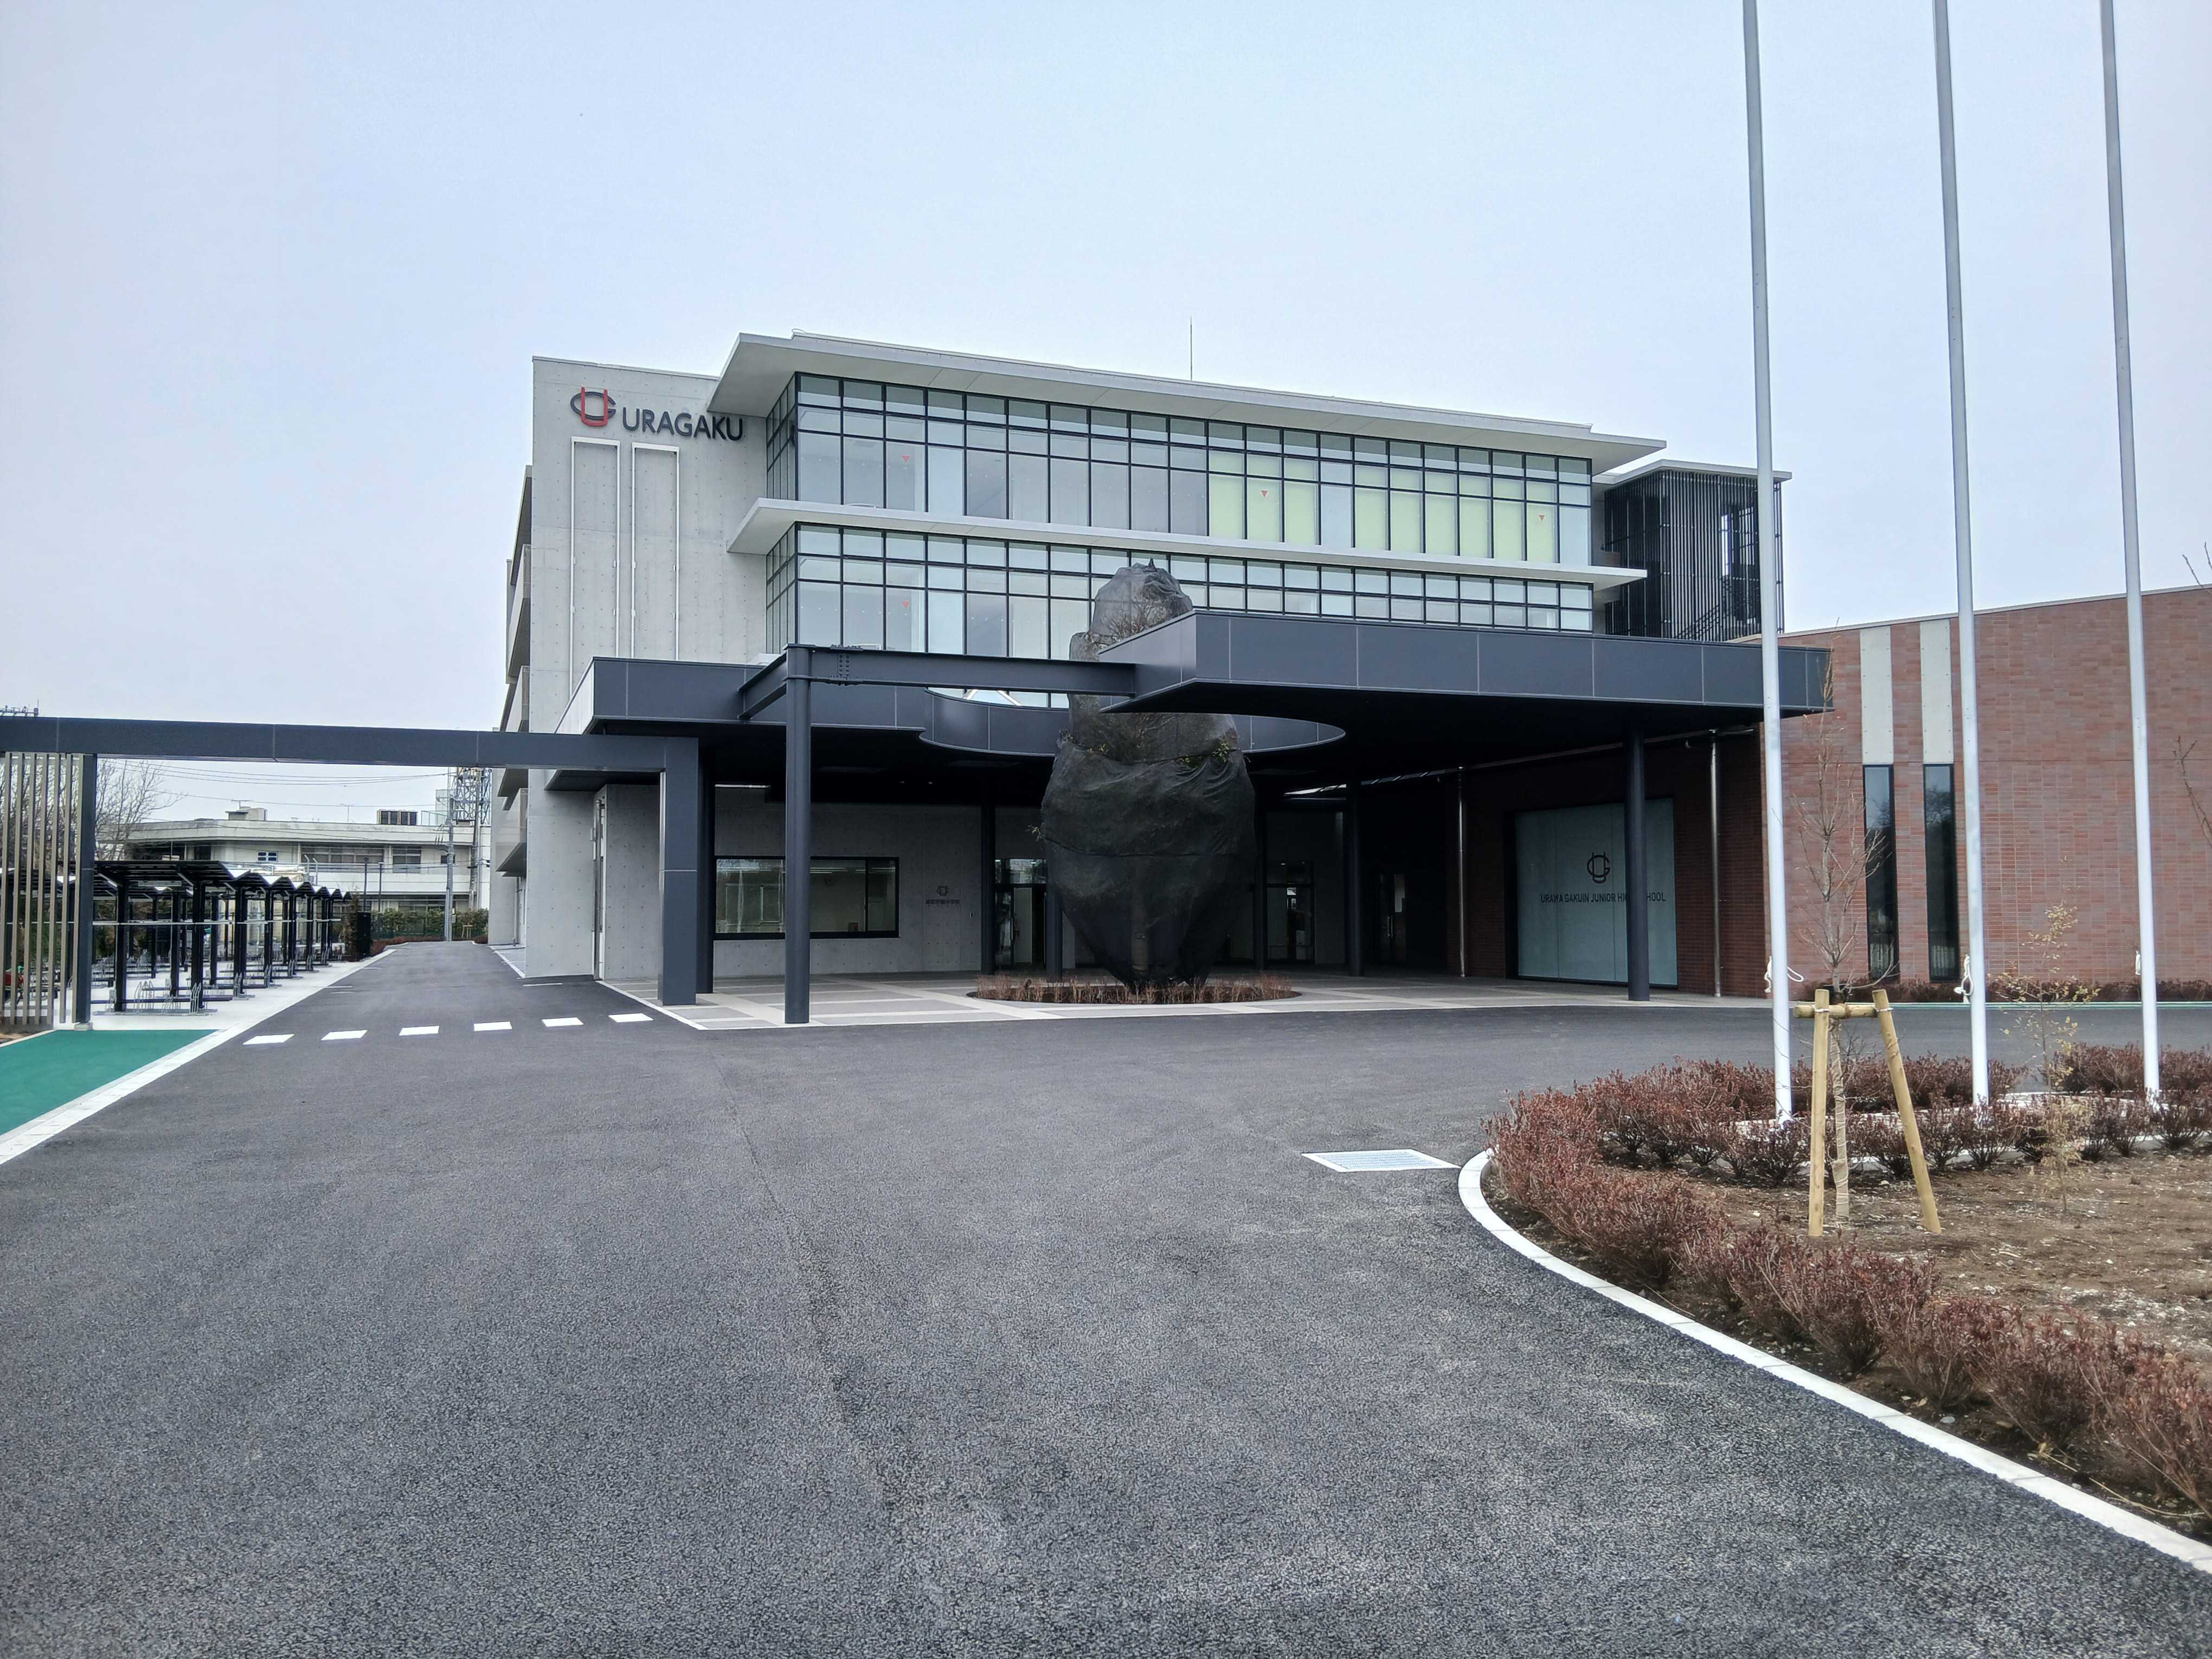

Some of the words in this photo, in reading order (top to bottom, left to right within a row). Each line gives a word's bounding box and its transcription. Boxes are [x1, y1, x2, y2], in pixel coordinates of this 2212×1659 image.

[622, 407, 743, 441] URAGAKU
[1541, 893, 1564, 902] URAWA
[1564, 893, 1589, 902] GAKUIN
[1591, 893, 1616, 902] JUNIOR
[1617, 893, 1626, 902] HI
[1647, 892, 1666, 902] HOOL
